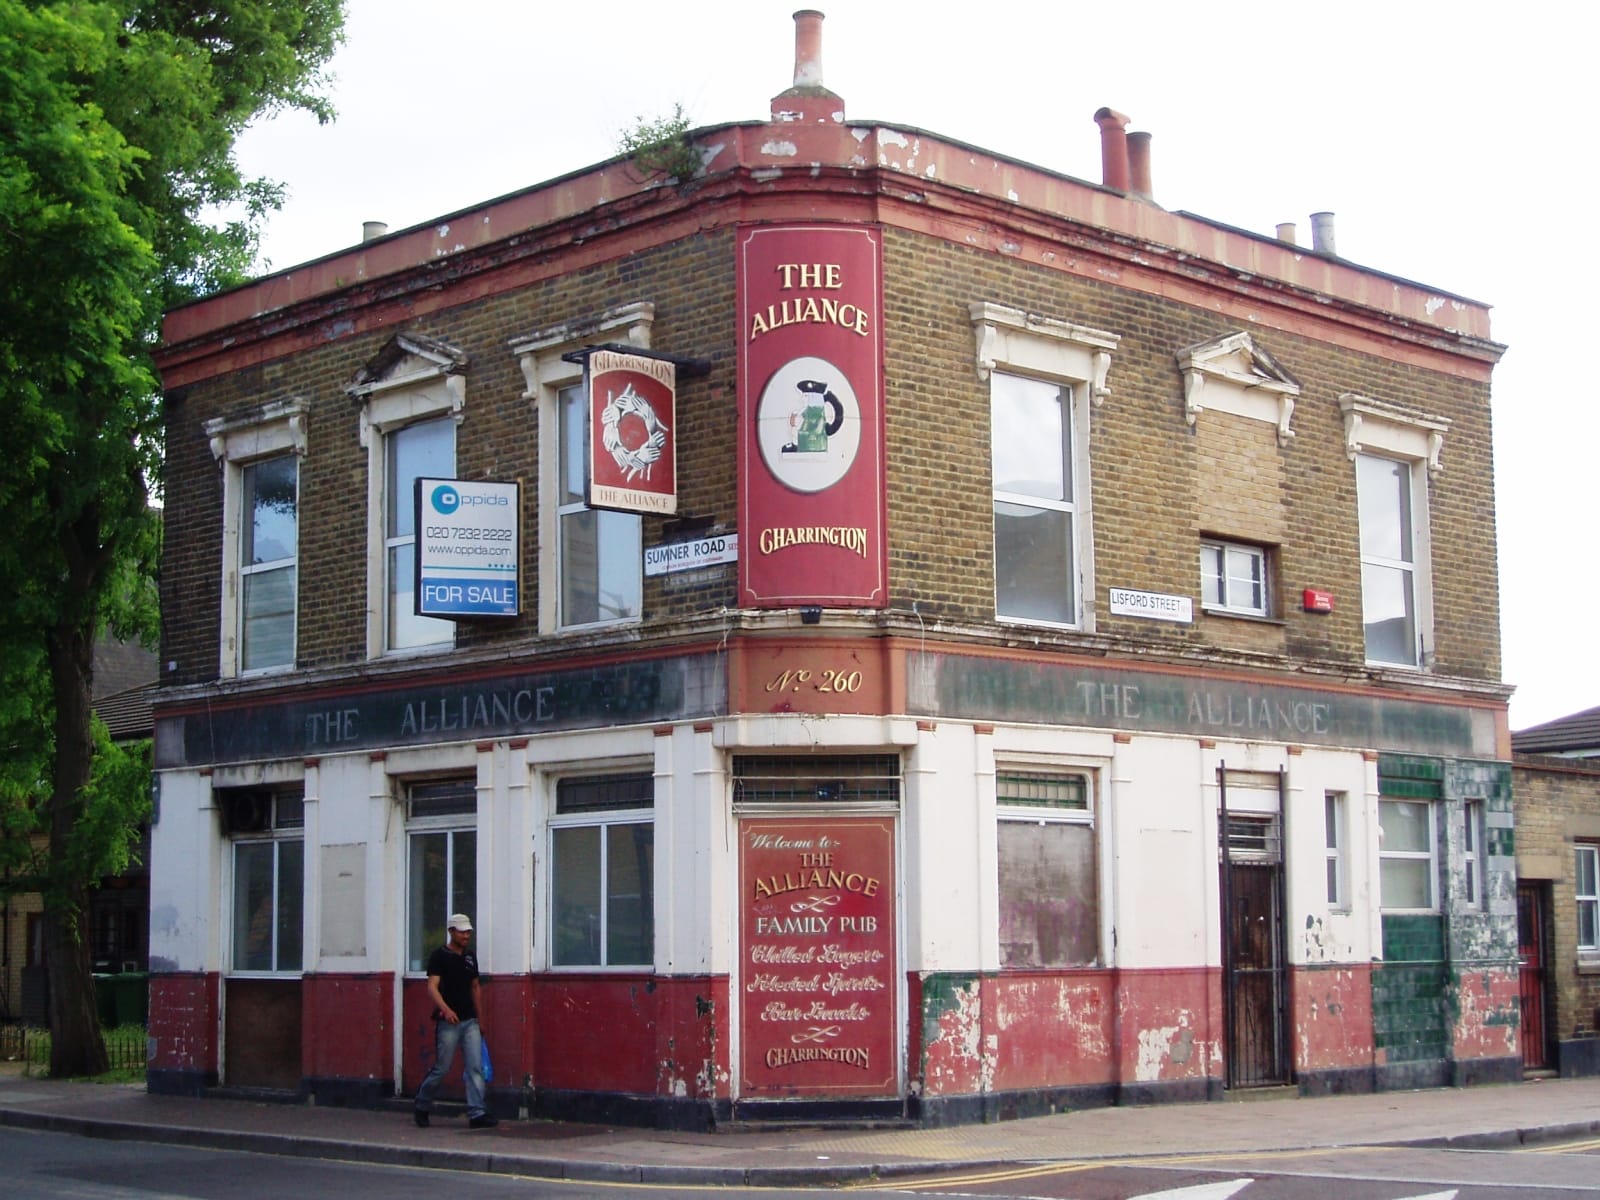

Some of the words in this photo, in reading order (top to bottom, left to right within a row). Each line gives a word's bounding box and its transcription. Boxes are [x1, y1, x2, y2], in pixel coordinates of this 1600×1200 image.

[777, 263, 843, 289] THE
[750, 297, 870, 339] ALLIANCE
[594, 352, 674, 384] CHARRINGTON
[441, 492, 509, 508] oppida
[600, 489, 618, 503] THE
[624, 493, 669, 509] ALLIANCE
[426, 527, 450, 539] 020
[452, 528, 481, 541] 7232
[482, 529, 512, 541] 2222
[759, 527, 868, 558] CHARRINGTON
[428, 546, 512, 557] www.oppida.com
[647, 545, 690, 564] SUMNER
[694, 539, 726, 556] ROAD
[425, 586, 463, 603] FOR
[468, 586, 513, 604] SALE
[1112, 592, 1148, 608] LISFORD
[1150, 597, 1181, 612] STREET
[818, 669, 863, 692] 260
[306, 709, 359, 744] THE
[400, 687, 554, 735] ALLIANCE
[1077, 681, 1140, 718] THE
[1188, 693, 1330, 733] ALLIANCE
[750, 833, 814, 849] Welcome
[800, 853, 834, 867] THE
[755, 869, 880, 899] ALLIANCE
[756, 917, 834, 934] FAMILY
[840, 916, 877, 933] PUB
[751, 945, 816, 963] Chilled
[817, 944, 884, 969] Lagers
[823, 972, 885, 996] Spirits
[761, 1003, 801, 1021] Bar
[803, 1002, 870, 1021] Snacks
[766, 1048, 869, 1068] CHARRINGTON
